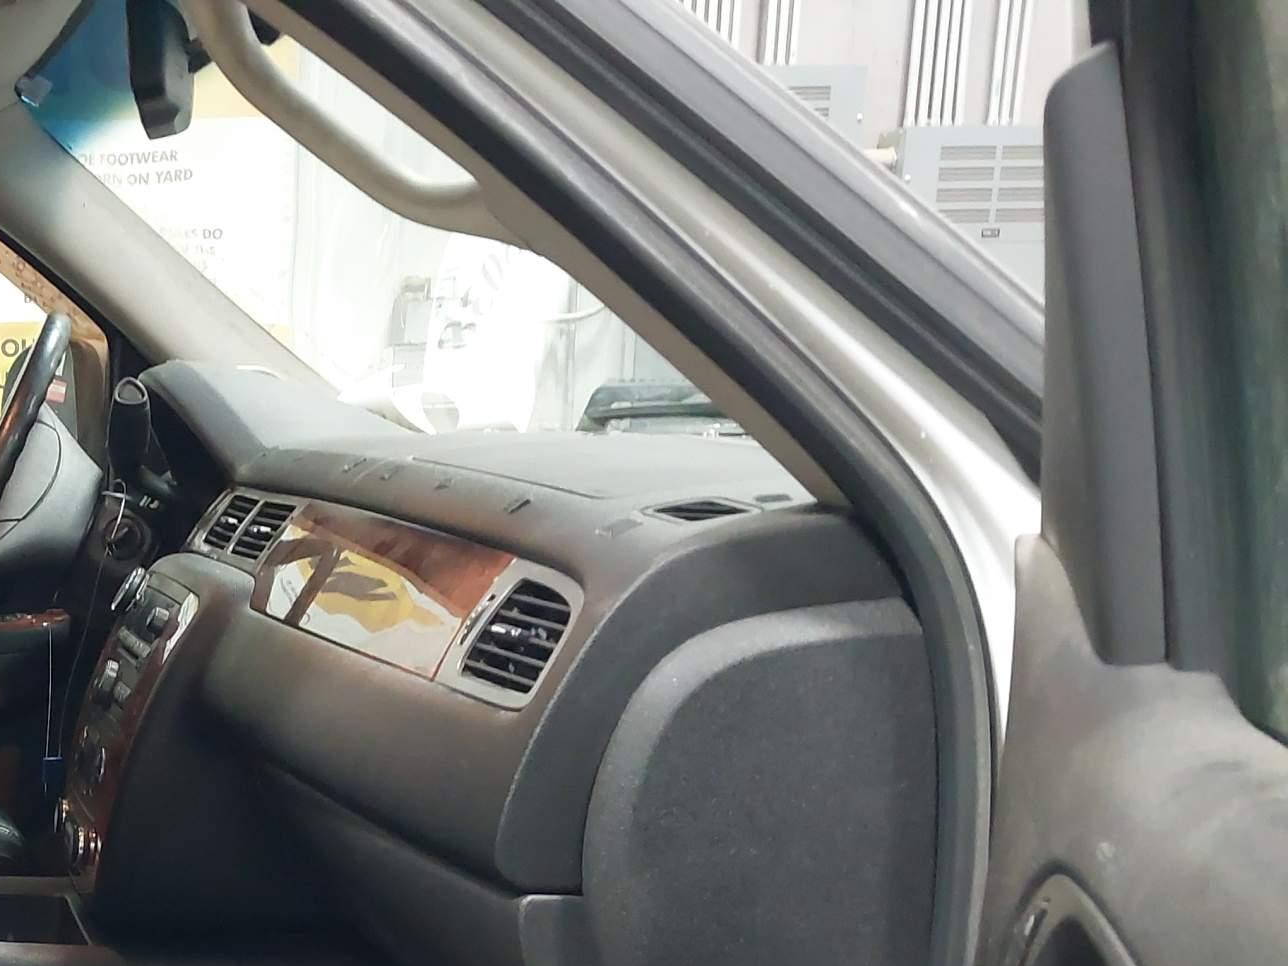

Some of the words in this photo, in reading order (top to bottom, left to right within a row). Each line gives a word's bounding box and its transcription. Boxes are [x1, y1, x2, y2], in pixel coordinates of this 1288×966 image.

[100, 150, 178, 166] FOOTWEAR
[127, 172, 150, 185] ON
[155, 168, 193, 184] YARD
[202, 228, 224, 240] DO
